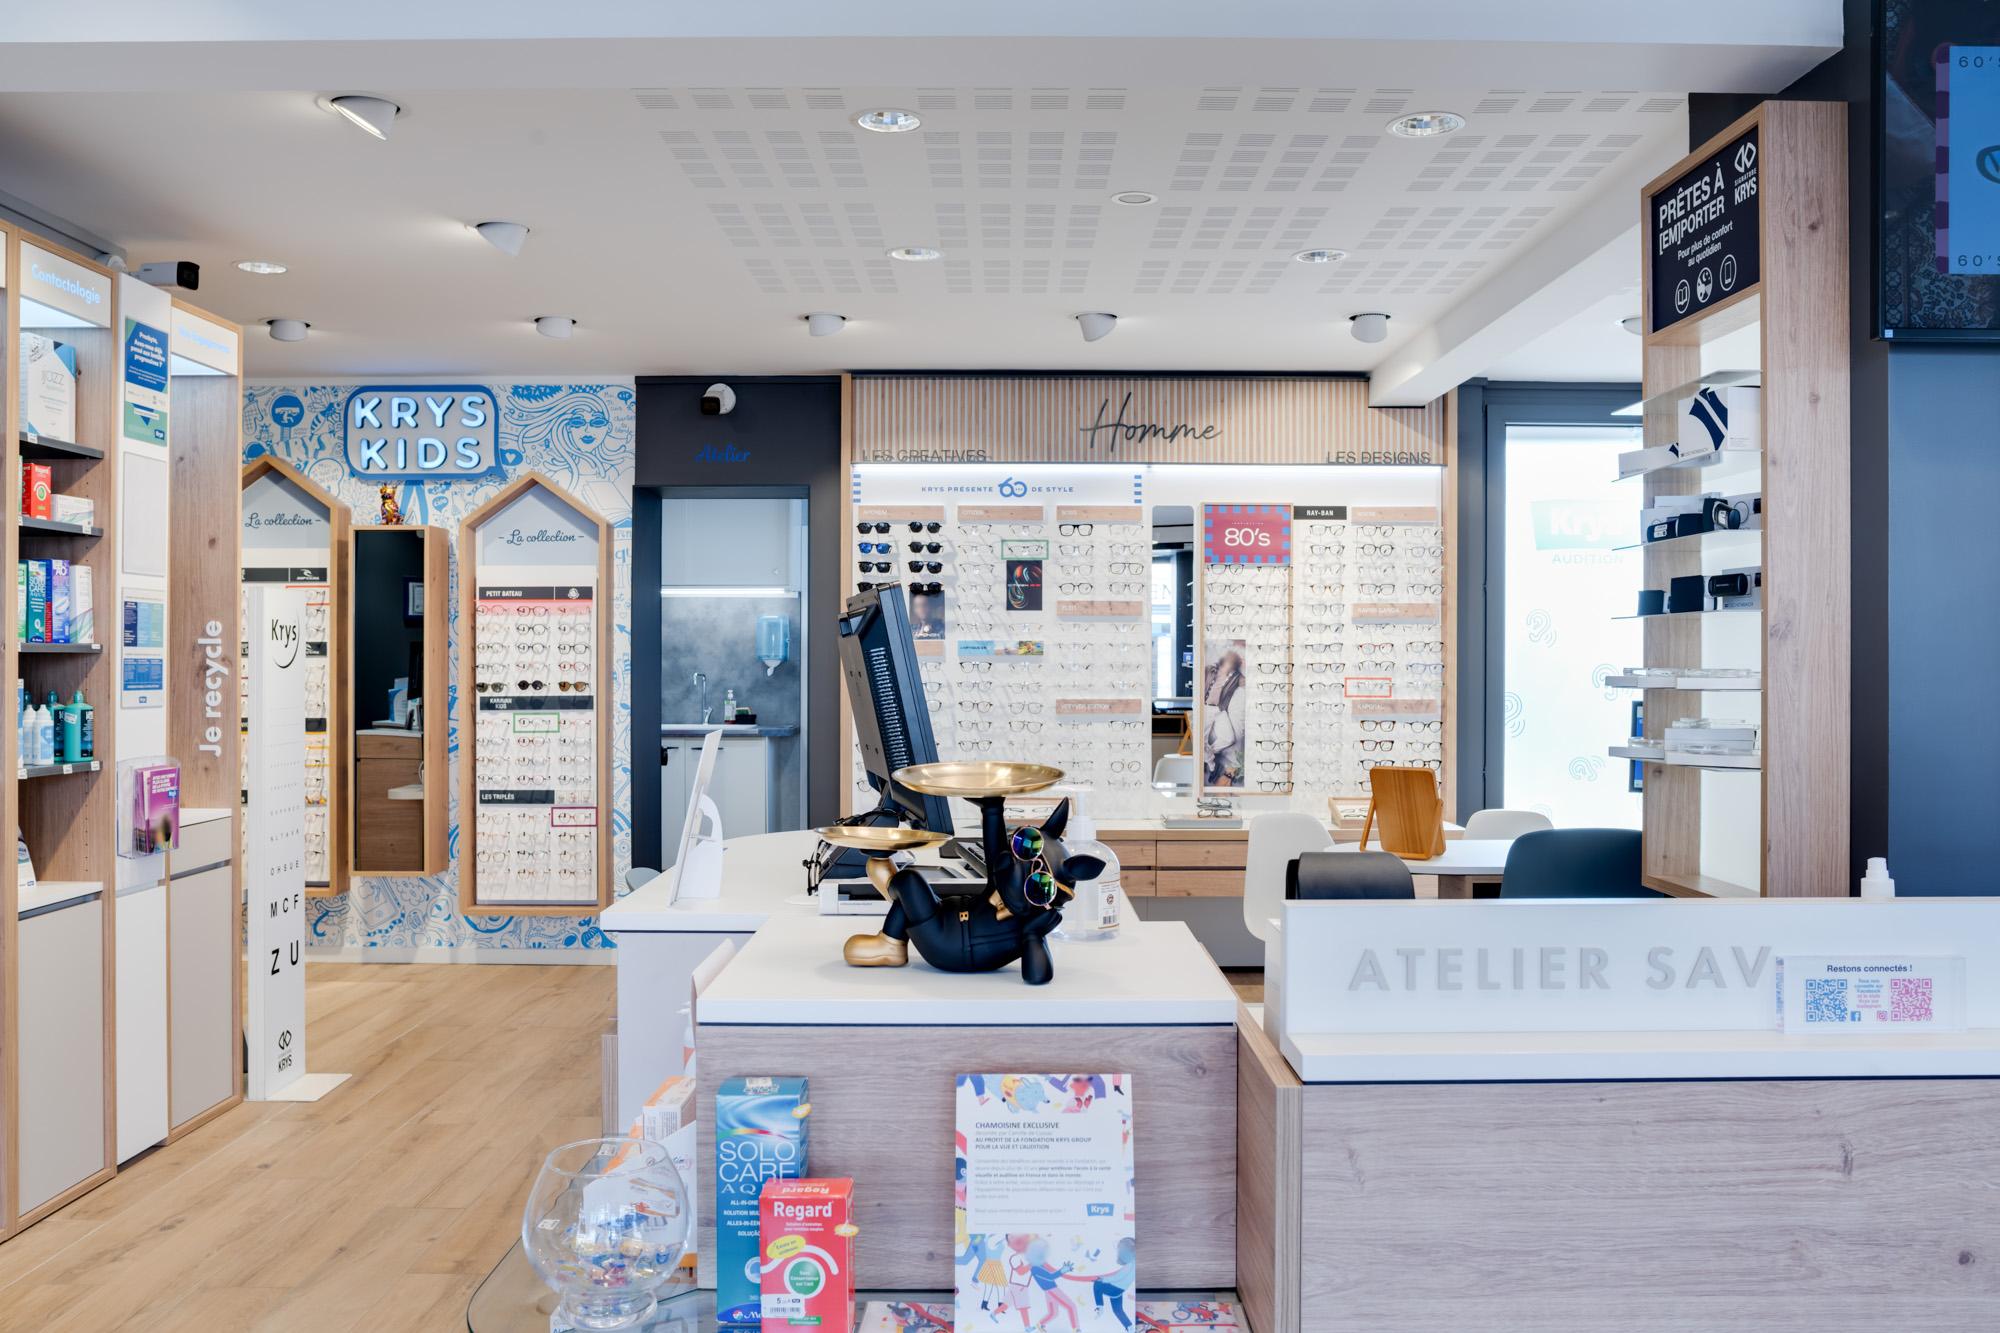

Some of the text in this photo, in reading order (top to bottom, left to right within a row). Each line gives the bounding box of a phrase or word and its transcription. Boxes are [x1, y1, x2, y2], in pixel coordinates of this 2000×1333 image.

[1659, 162, 1725, 230] PRÊTES À
[1734, 177, 1757, 206] KRYS
[1659, 195, 1725, 255] [EM]PORTER
[1677, 220, 1733, 261] Pour plus de confort
[1687, 241, 1722, 267] au quotidien
[31, 263, 101, 304] Contactologie
[354, 396, 487, 429] KRYS
[1080, 391, 1223, 452] Homme
[360, 437, 482, 471] KIDS
[693, 442, 751, 464] Atelier
[862, 449, 892, 462] LES
[1327, 451, 1432, 465] LES DESIGNS
[998, 476, 1028, 498] 60
[244, 512, 314, 528] La collection
[506, 529, 577, 545] La collection
[1224, 527, 1271, 547] 80's
[271, 619, 297, 648] Krys
[197, 620, 229, 757] Je recycle
[1347, 945, 1773, 992] ATELIER SAV
[1826, 964, 1862, 973] Restons
[1863, 964, 1908, 973] connectés
[278, 1054, 292, 1073] KRYS
[975, 1121, 1060, 1129] CHAMOISINE EXCLUSIVE
[719, 1140, 796, 1162] SOLO
[719, 1161, 797, 1183] CARE
[773, 1201, 833, 1221] Regard
[1090, 1205, 1110, 1215] Krys
